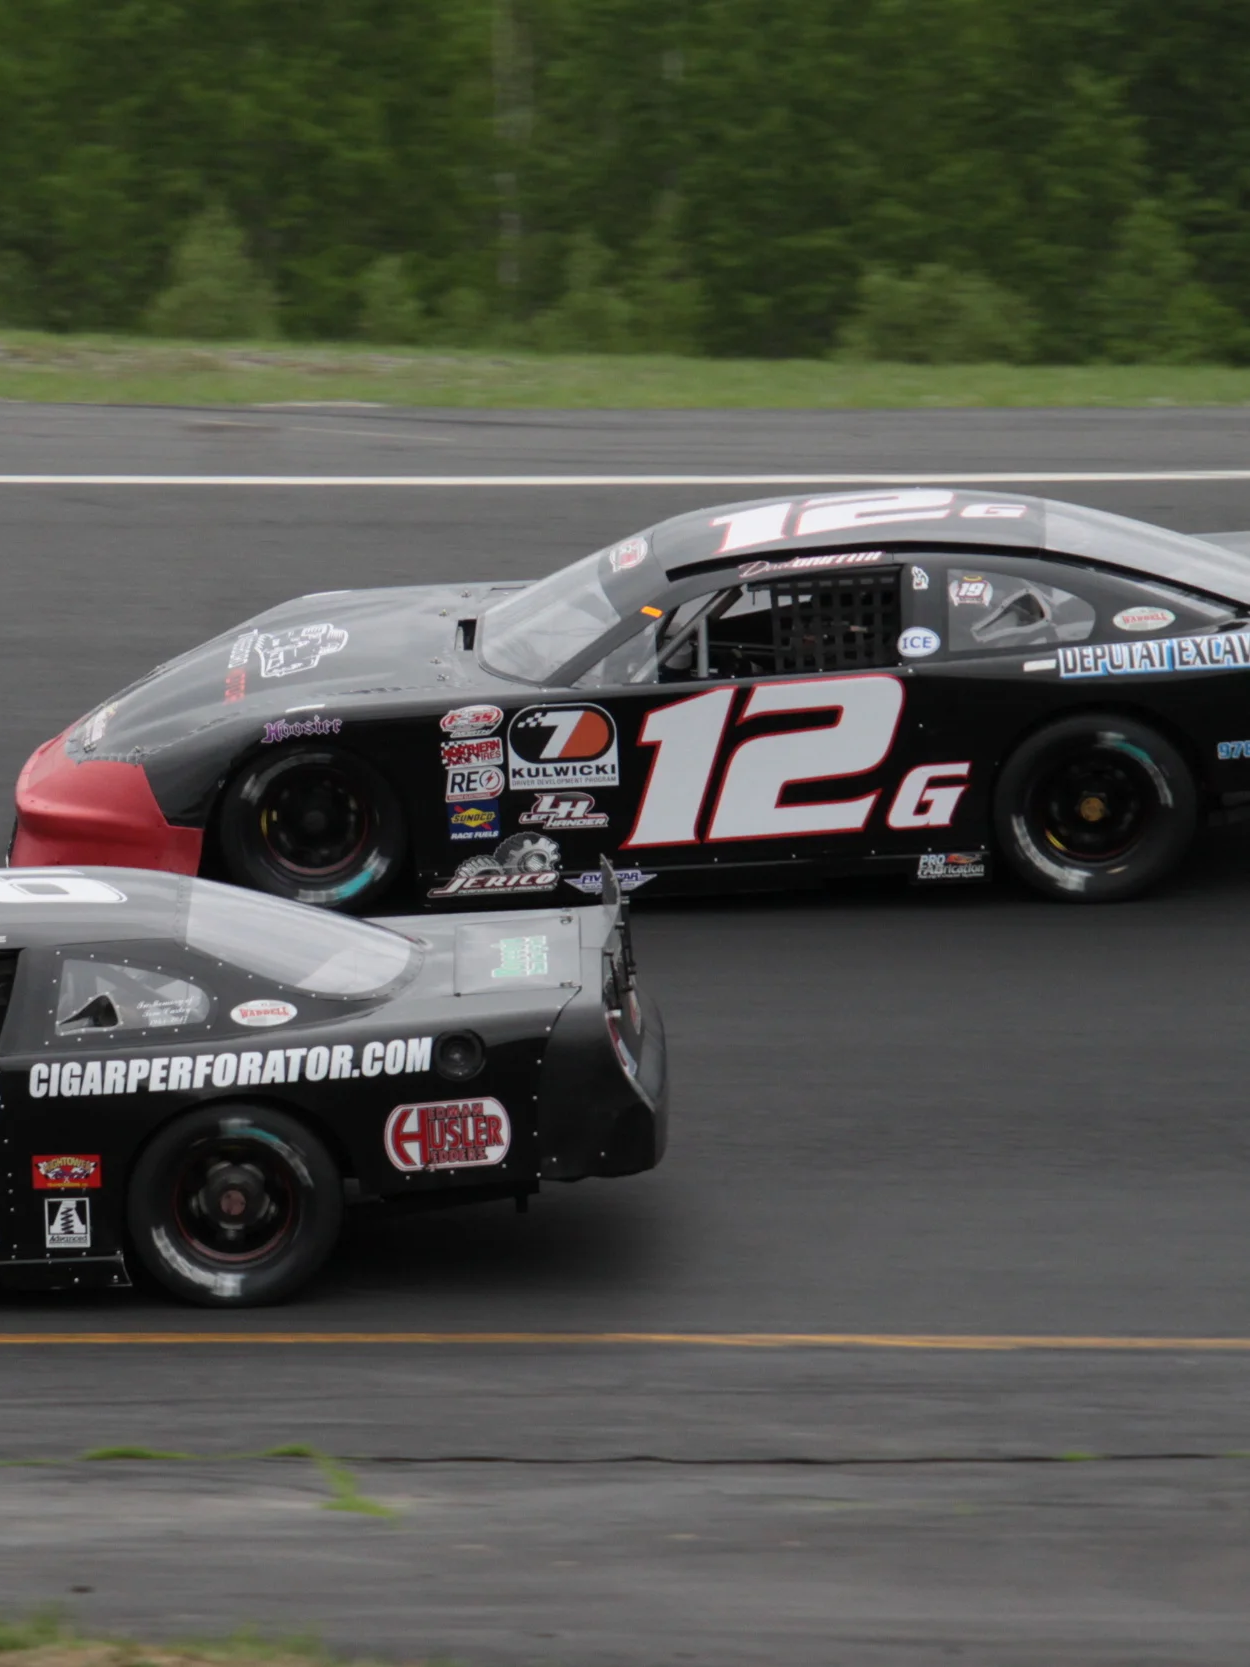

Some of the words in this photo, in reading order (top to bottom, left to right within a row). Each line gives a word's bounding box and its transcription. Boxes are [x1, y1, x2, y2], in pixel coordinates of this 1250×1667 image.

[710, 490, 955, 555] 12
[958, 582, 986, 597] 19
[901, 636, 933, 649] ICE
[1059, 640, 1171, 677] DEPUTAT
[261, 715, 342, 743] Hoosier
[618, 673, 905, 849] 12
[886, 761, 972, 830] G
[511, 763, 616, 779] KULWICKI
[537, 777, 583, 785] DEVELOPMENT
[451, 812, 494, 823] SUNOCO
[522, 813, 554, 823] LEFT
[919, 853, 946, 865] PRO
[432, 872, 557, 894] JERICO
[29, 1036, 432, 1098] CIGARPERFORATOR.COM
